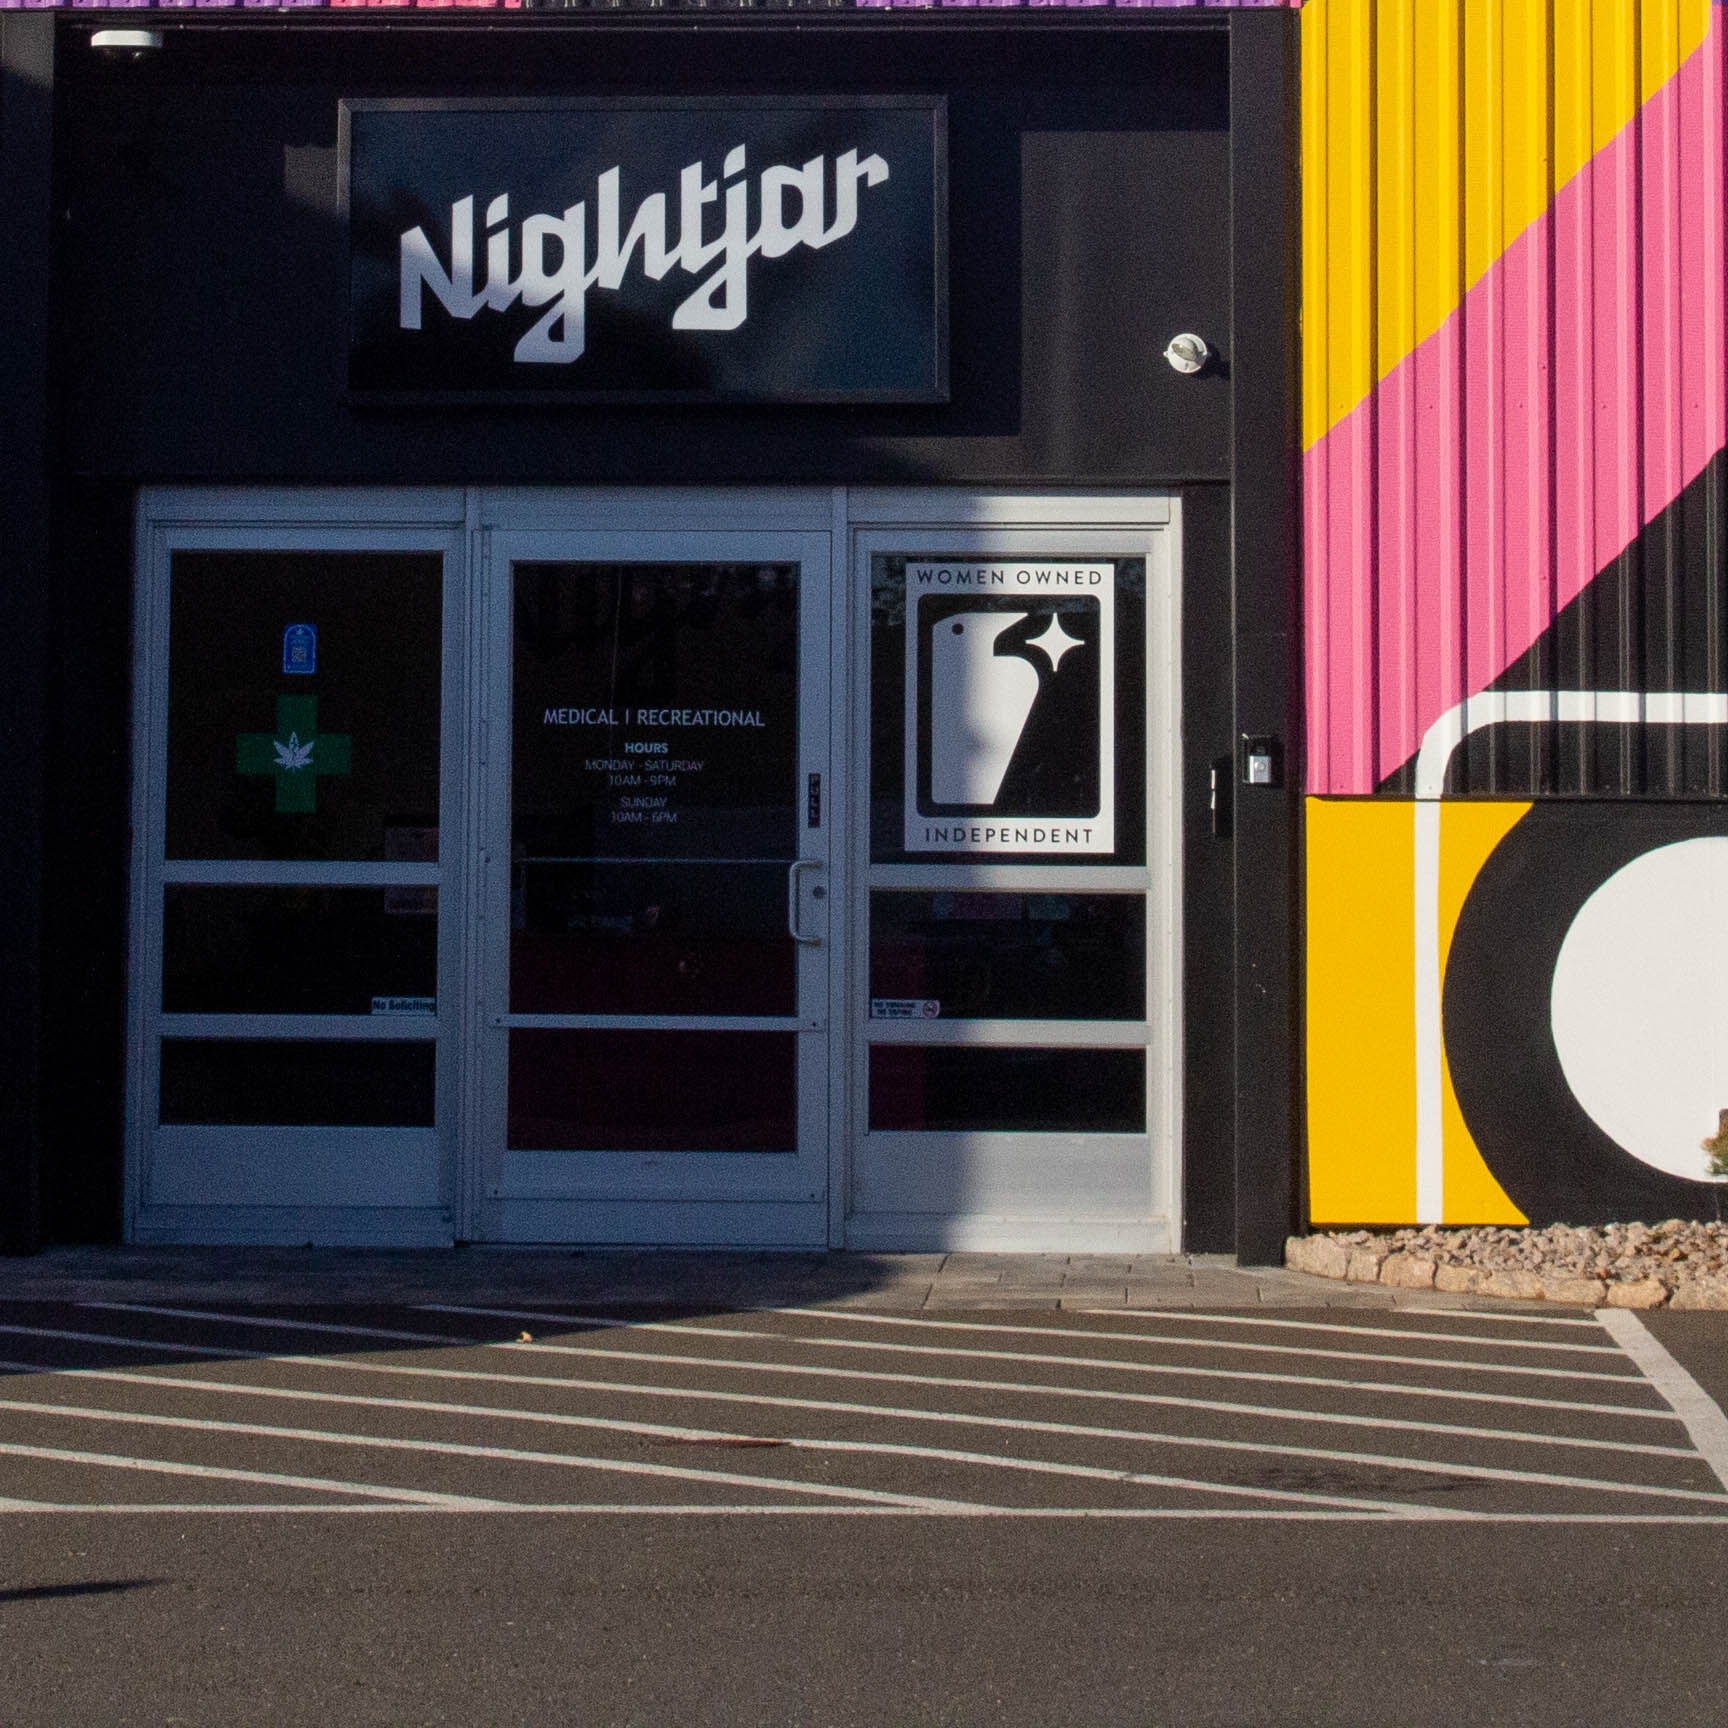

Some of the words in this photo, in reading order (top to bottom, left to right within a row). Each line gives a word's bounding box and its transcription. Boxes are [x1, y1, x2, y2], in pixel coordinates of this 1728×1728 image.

[400, 143, 889, 363] Nightjar
[917, 570, 1004, 585] WOMEN
[1016, 570, 1102, 585] OWNED
[543, 708, 619, 726] MEDICAL
[637, 709, 766, 727] RECREATIONAL
[624, 742, 669, 754] HOURS
[584, 759, 634, 771] MONDAY
[644, 759, 704, 771] SATURDAY
[620, 797, 668, 808] SUNDAY
[925, 828, 1093, 844] INDEPENDENT
[373, 999, 386, 1010] No
